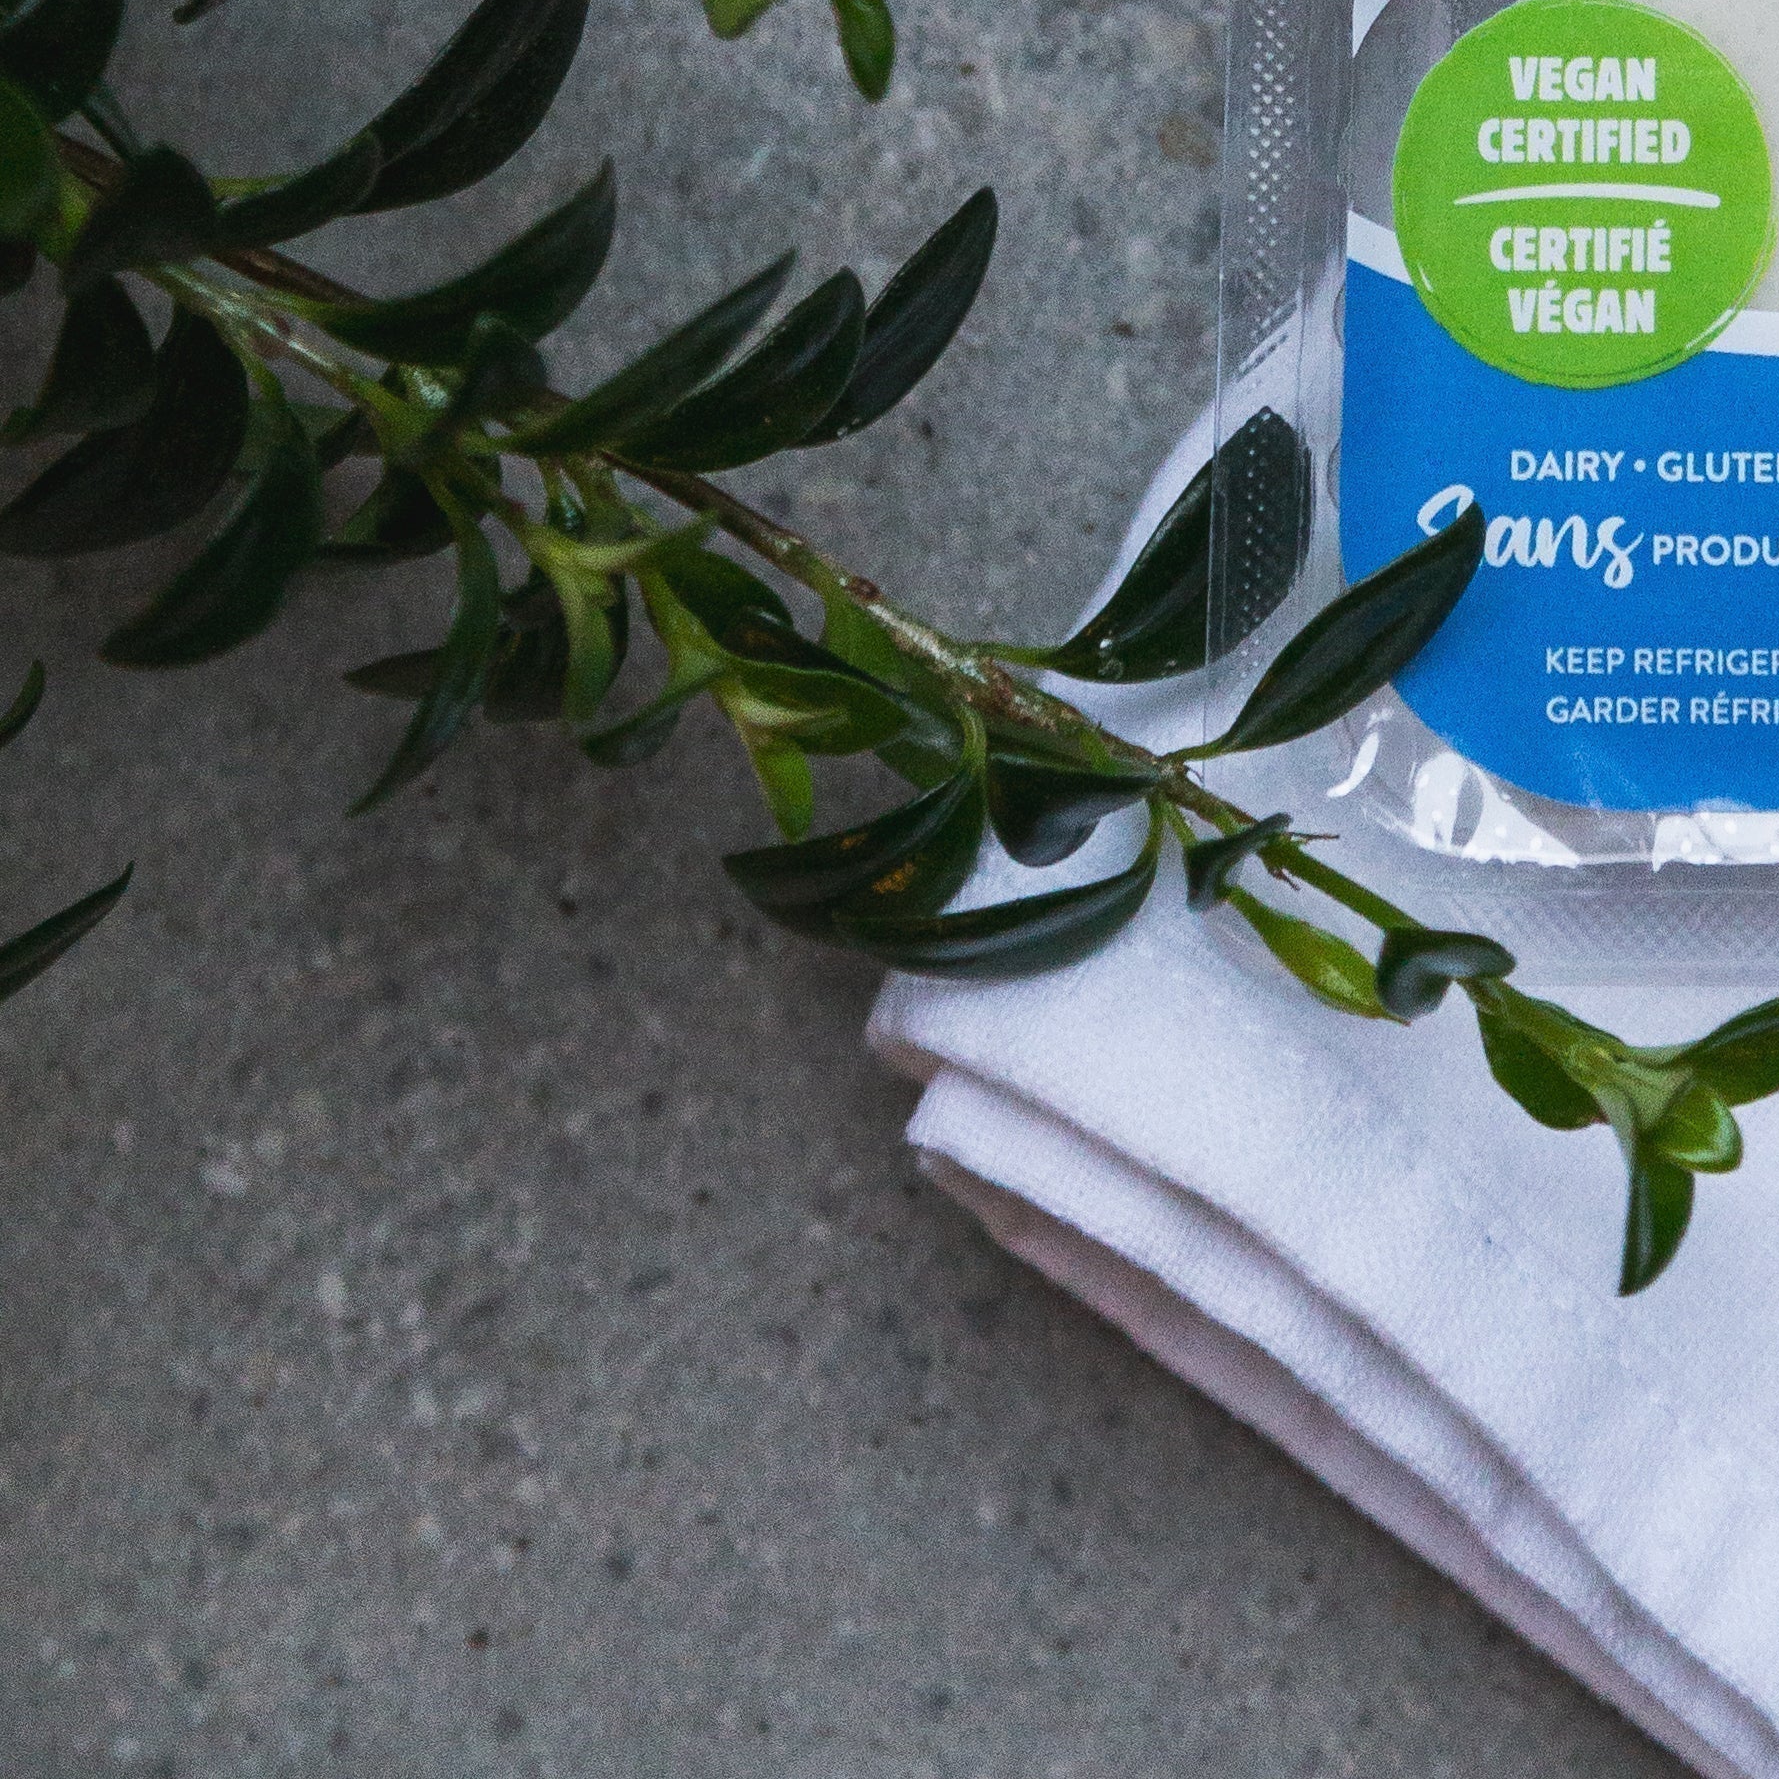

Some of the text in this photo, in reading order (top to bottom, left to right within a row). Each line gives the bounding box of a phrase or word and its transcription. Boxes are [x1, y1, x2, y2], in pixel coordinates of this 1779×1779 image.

[1509, 57, 1656, 101] VEGAN
[1477, 118, 1691, 163] CERTIFIED
[1490, 219, 1672, 272] CERTIFIÉ
[1508, 280, 1655, 333] VÉGAN
[1510, 450, 1625, 481] DAIRY
[1546, 647, 1624, 675] KEEP
[1545, 695, 1680, 725] GARDER
